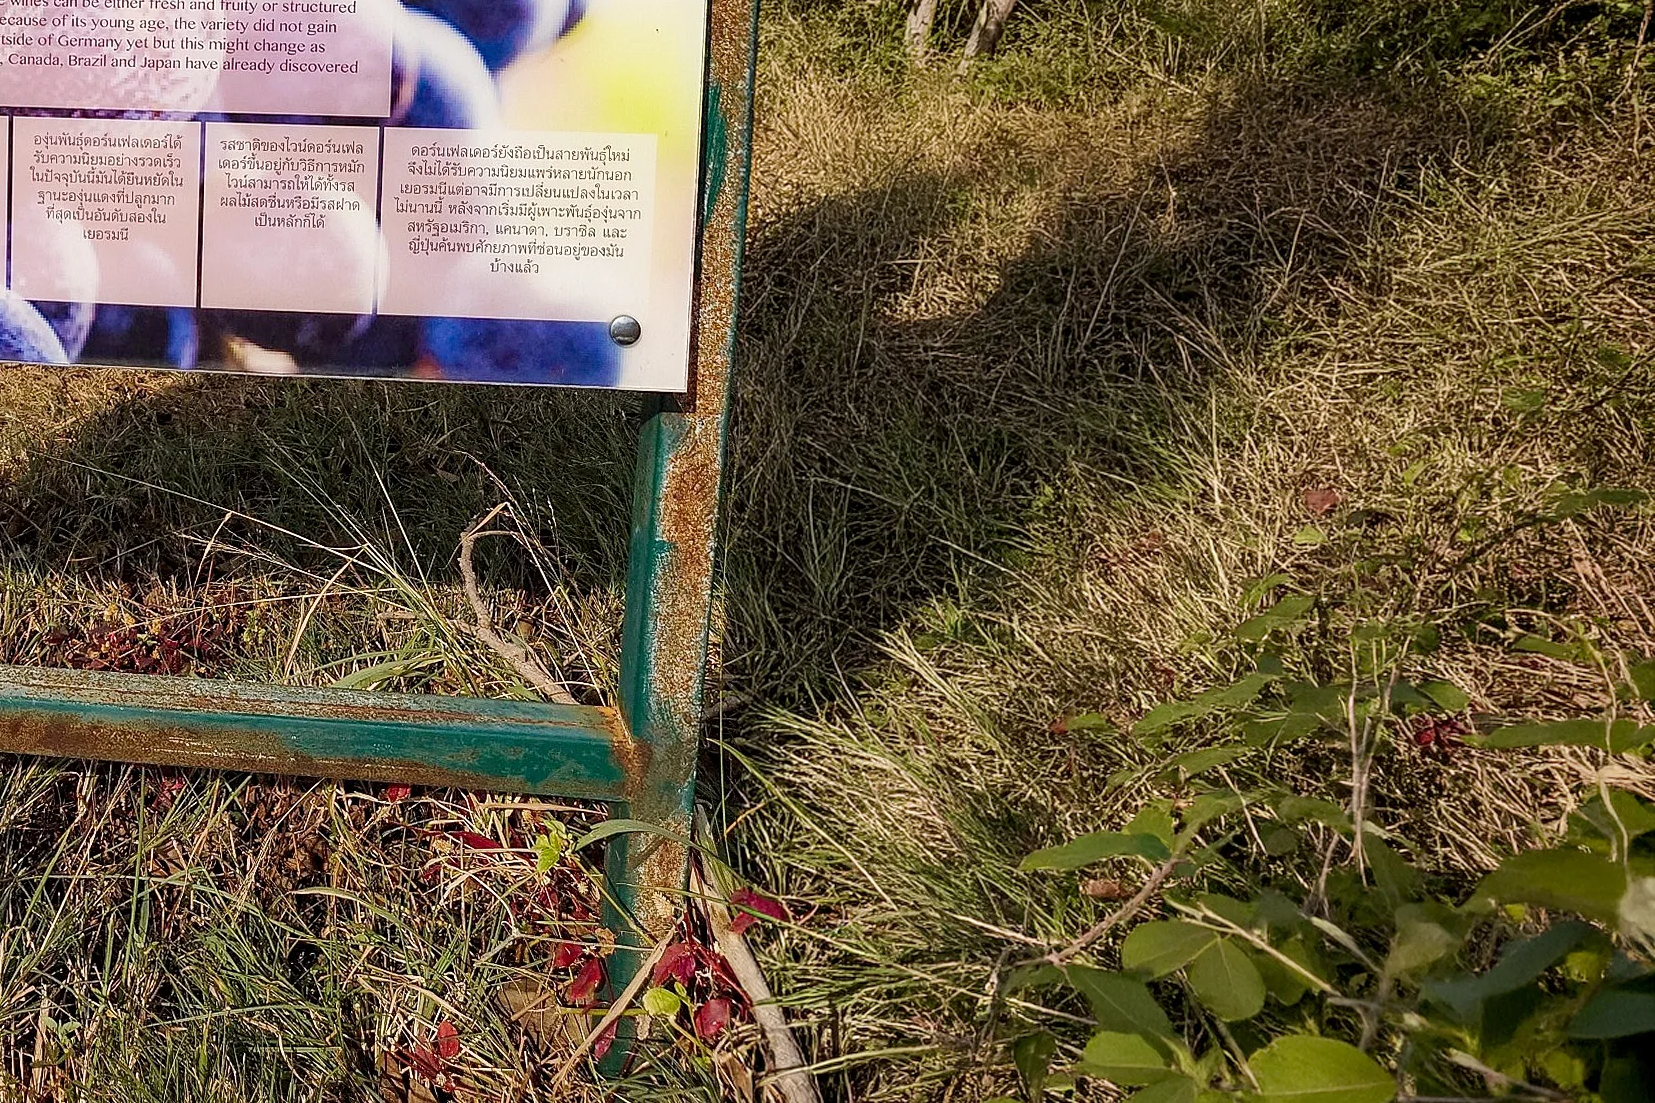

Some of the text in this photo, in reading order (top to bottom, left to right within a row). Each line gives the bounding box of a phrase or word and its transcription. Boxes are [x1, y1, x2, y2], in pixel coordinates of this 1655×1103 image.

[190, 0, 214, 11] and
[262, 2, 278, 12] or
[282, 1, 356, 13] structured
[52, 14, 68, 27] of
[71, 15, 86, 27] its
[91, 19, 134, 31] young
[140, 19, 169, 31] age,
[174, 18, 196, 29] the
[201, 19, 248, 33] variety
[253, 19, 274, 32] did
[279, 21, 303, 32] not
[307, 21, 337, 35] gain
[38, 34, 54, 46] of
[58, 35, 122, 50] Germany
[127, 38, 148, 51] yet
[154, 37, 175, 49] but
[181, 38, 204, 50] this
[209, 39, 249, 54] might
[254, 40, 305, 55] change
[310, 42, 325, 52] as
[8, 53, 63, 67] Canada,
[69, 54, 106, 67] Brazil
[110, 55, 136, 68] and
[141, 57, 181, 71] Japan
[185, 58, 218, 70] have
[223, 58, 275, 74] already
[280, 60, 358, 74] discovered
[83, 228, 128, 241] เยอรมนี
[554, 224, 596, 238] บราซิล
[602, 227, 627, 238] และ
[490, 258, 539, 274] บ้างแล้ว
